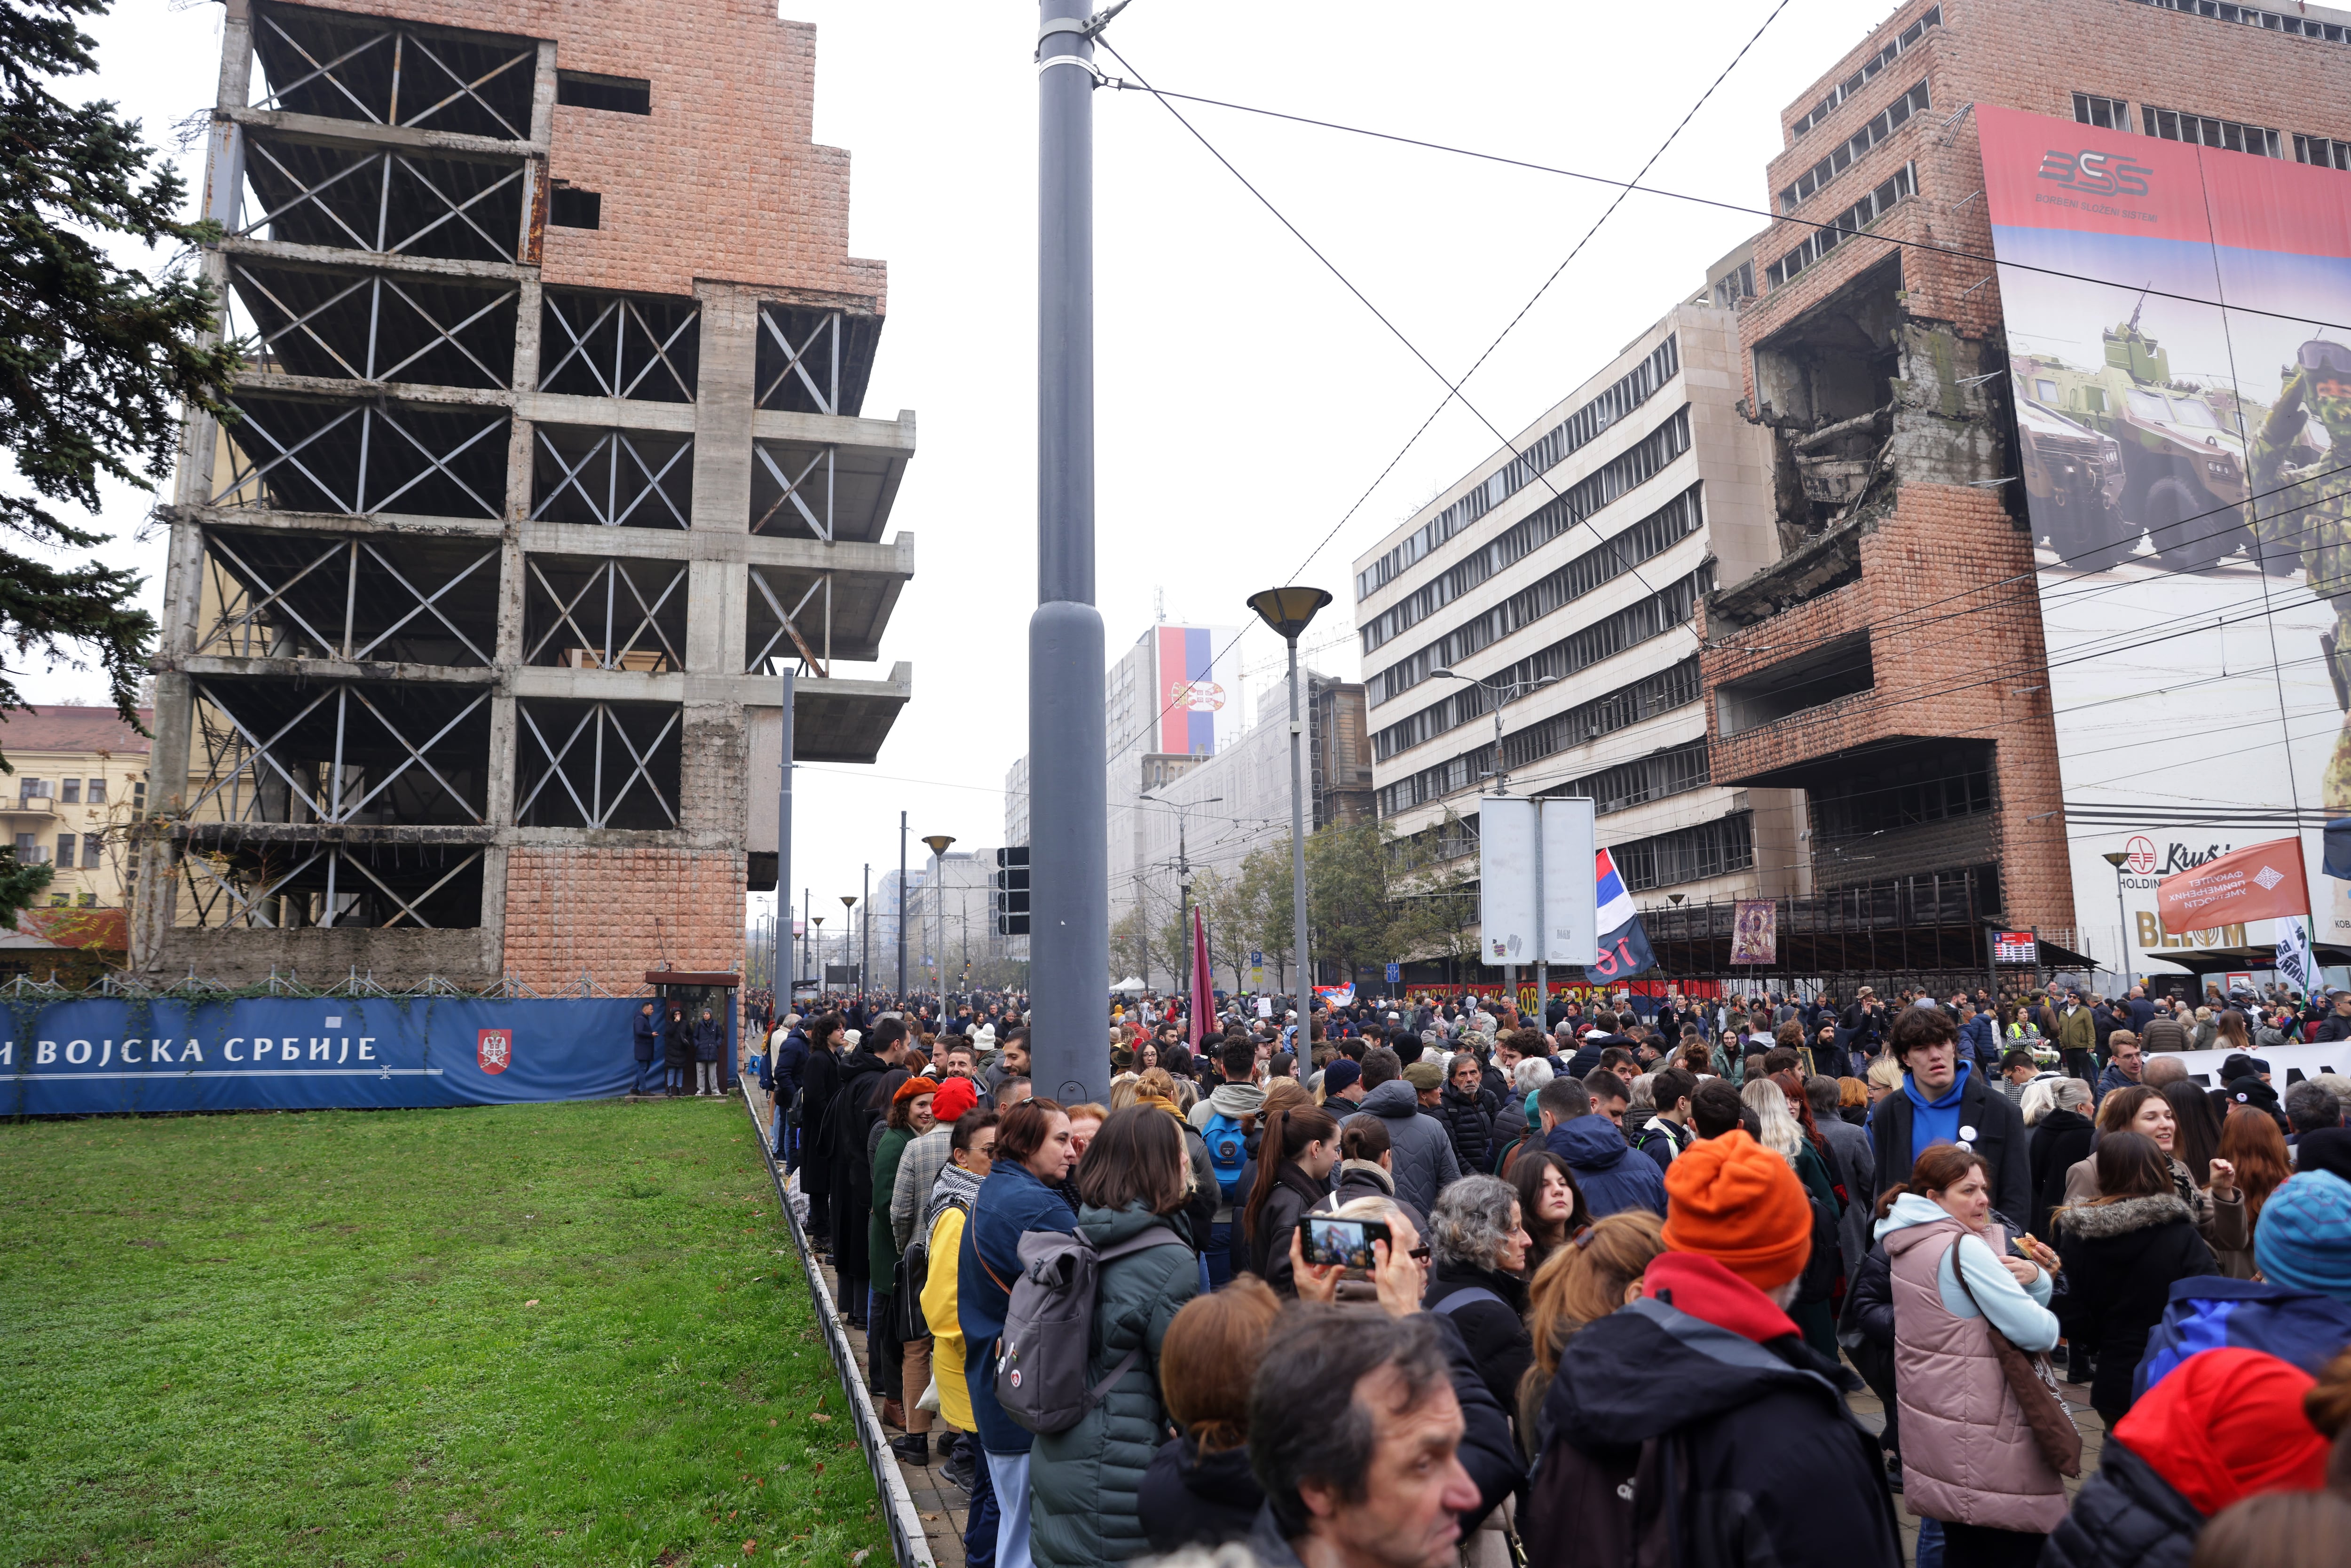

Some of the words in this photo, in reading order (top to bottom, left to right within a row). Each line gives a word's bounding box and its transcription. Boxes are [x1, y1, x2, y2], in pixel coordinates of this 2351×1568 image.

[2037, 149, 2154, 197] BSS
[2035, 193, 2078, 208] BORBENI
[2081, 203, 2120, 217] SLOŽENI
[2122, 210, 2158, 223] SISTEMI
[36, 1039, 203, 1067] ВОЈСКА
[224, 1038, 376, 1064] СРБИЈЕ
